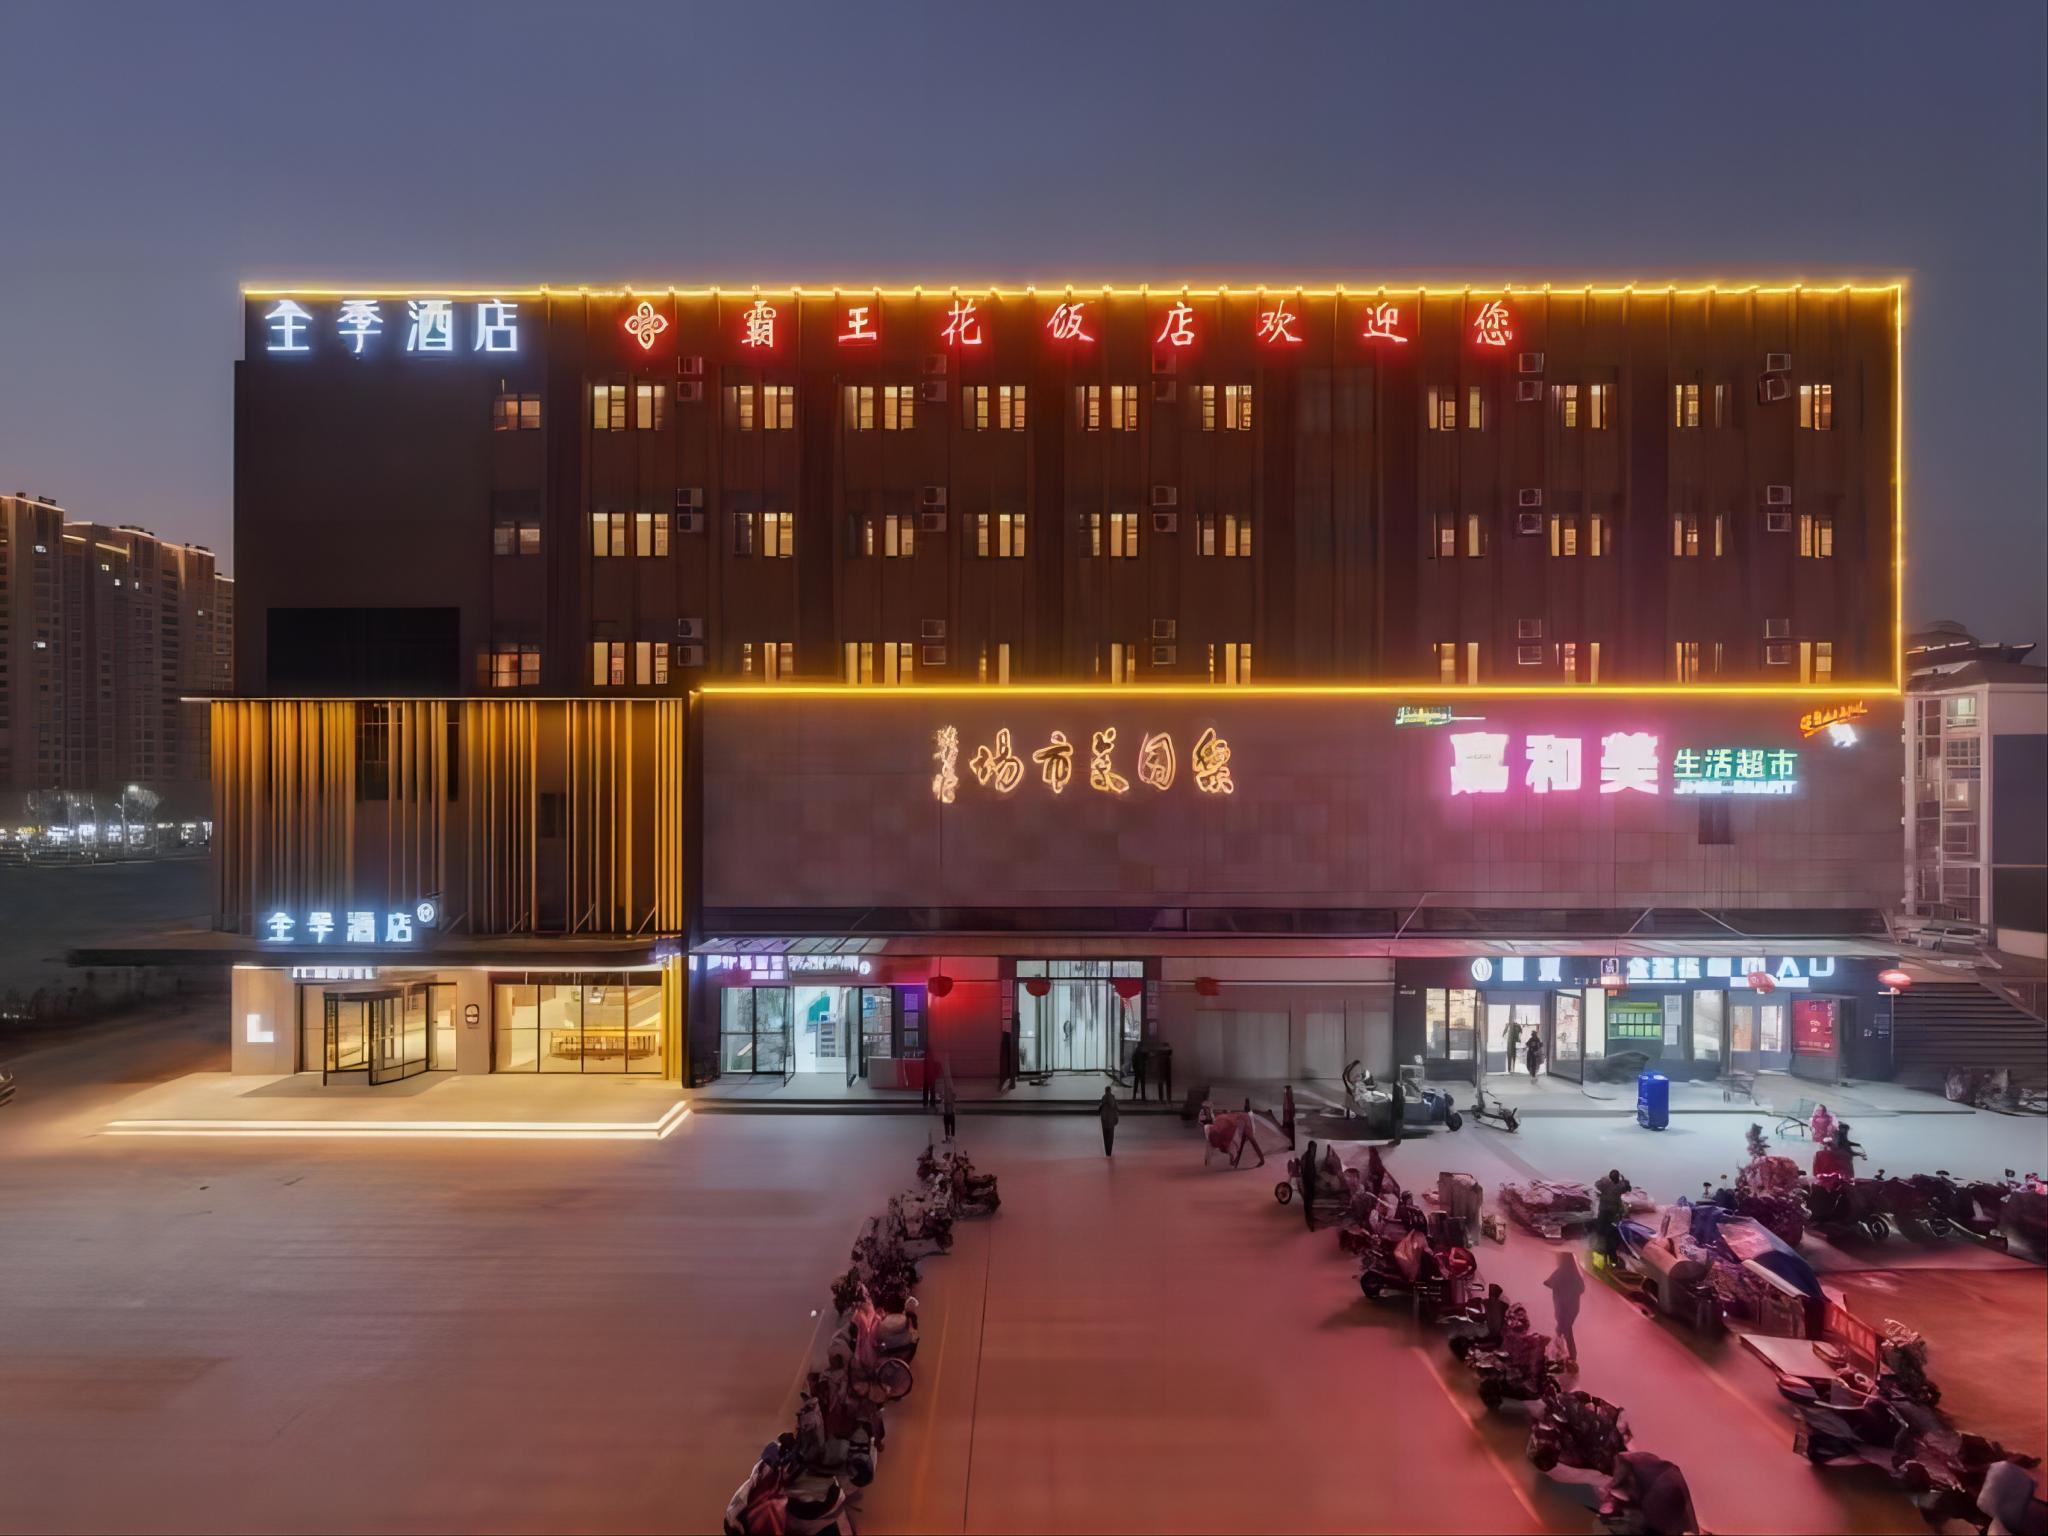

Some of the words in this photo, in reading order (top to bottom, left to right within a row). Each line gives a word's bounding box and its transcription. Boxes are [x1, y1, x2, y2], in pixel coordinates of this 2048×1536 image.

[265, 298, 518, 354] 全季酒店
[741, 299, 1513, 347] 霸王花饭店欢迎您
[1673, 748, 1797, 780] 生活超市
[266, 911, 413, 943] 全季酒店
